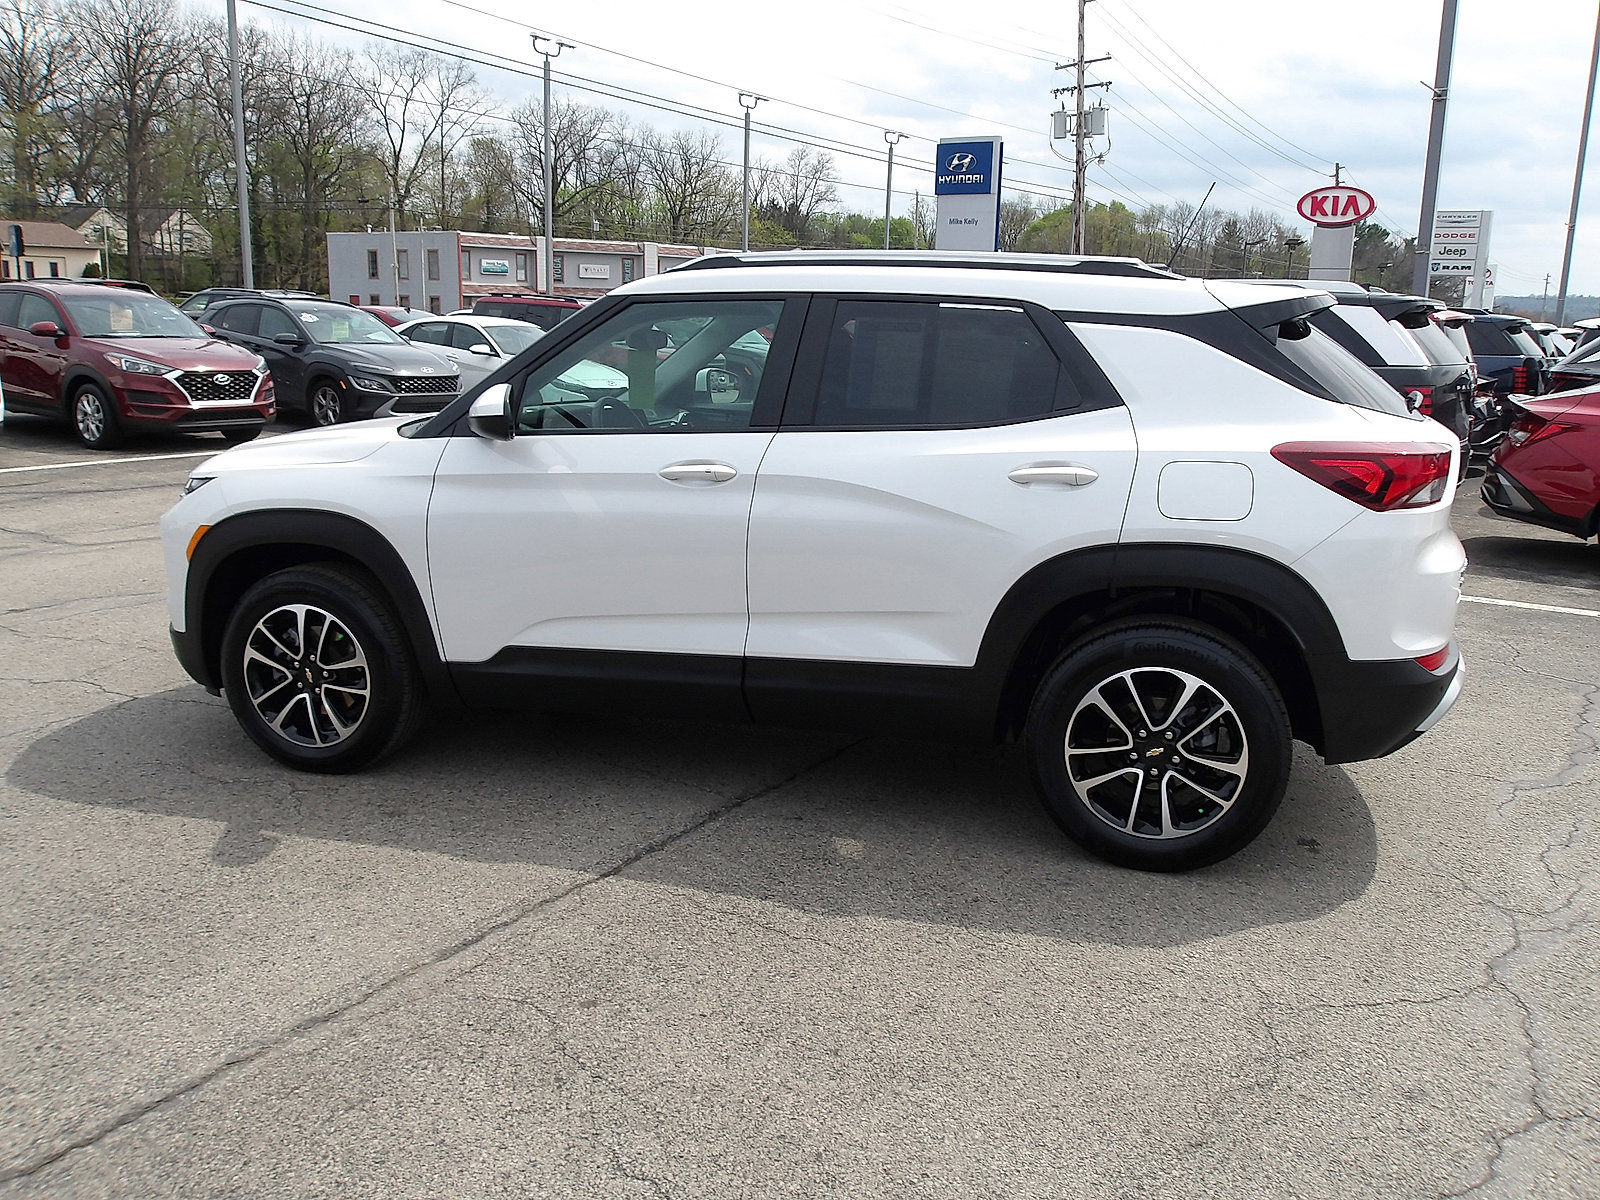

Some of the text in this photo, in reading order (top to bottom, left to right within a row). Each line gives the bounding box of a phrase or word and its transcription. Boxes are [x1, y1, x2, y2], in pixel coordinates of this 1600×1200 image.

[938, 174, 984, 184] HYUNDAI
[1310, 195, 1361, 216] KIA
[963, 218, 979, 226] Kelly
[1438, 246, 1467, 257] Jeep
[553, 257, 561, 280] YOGA
